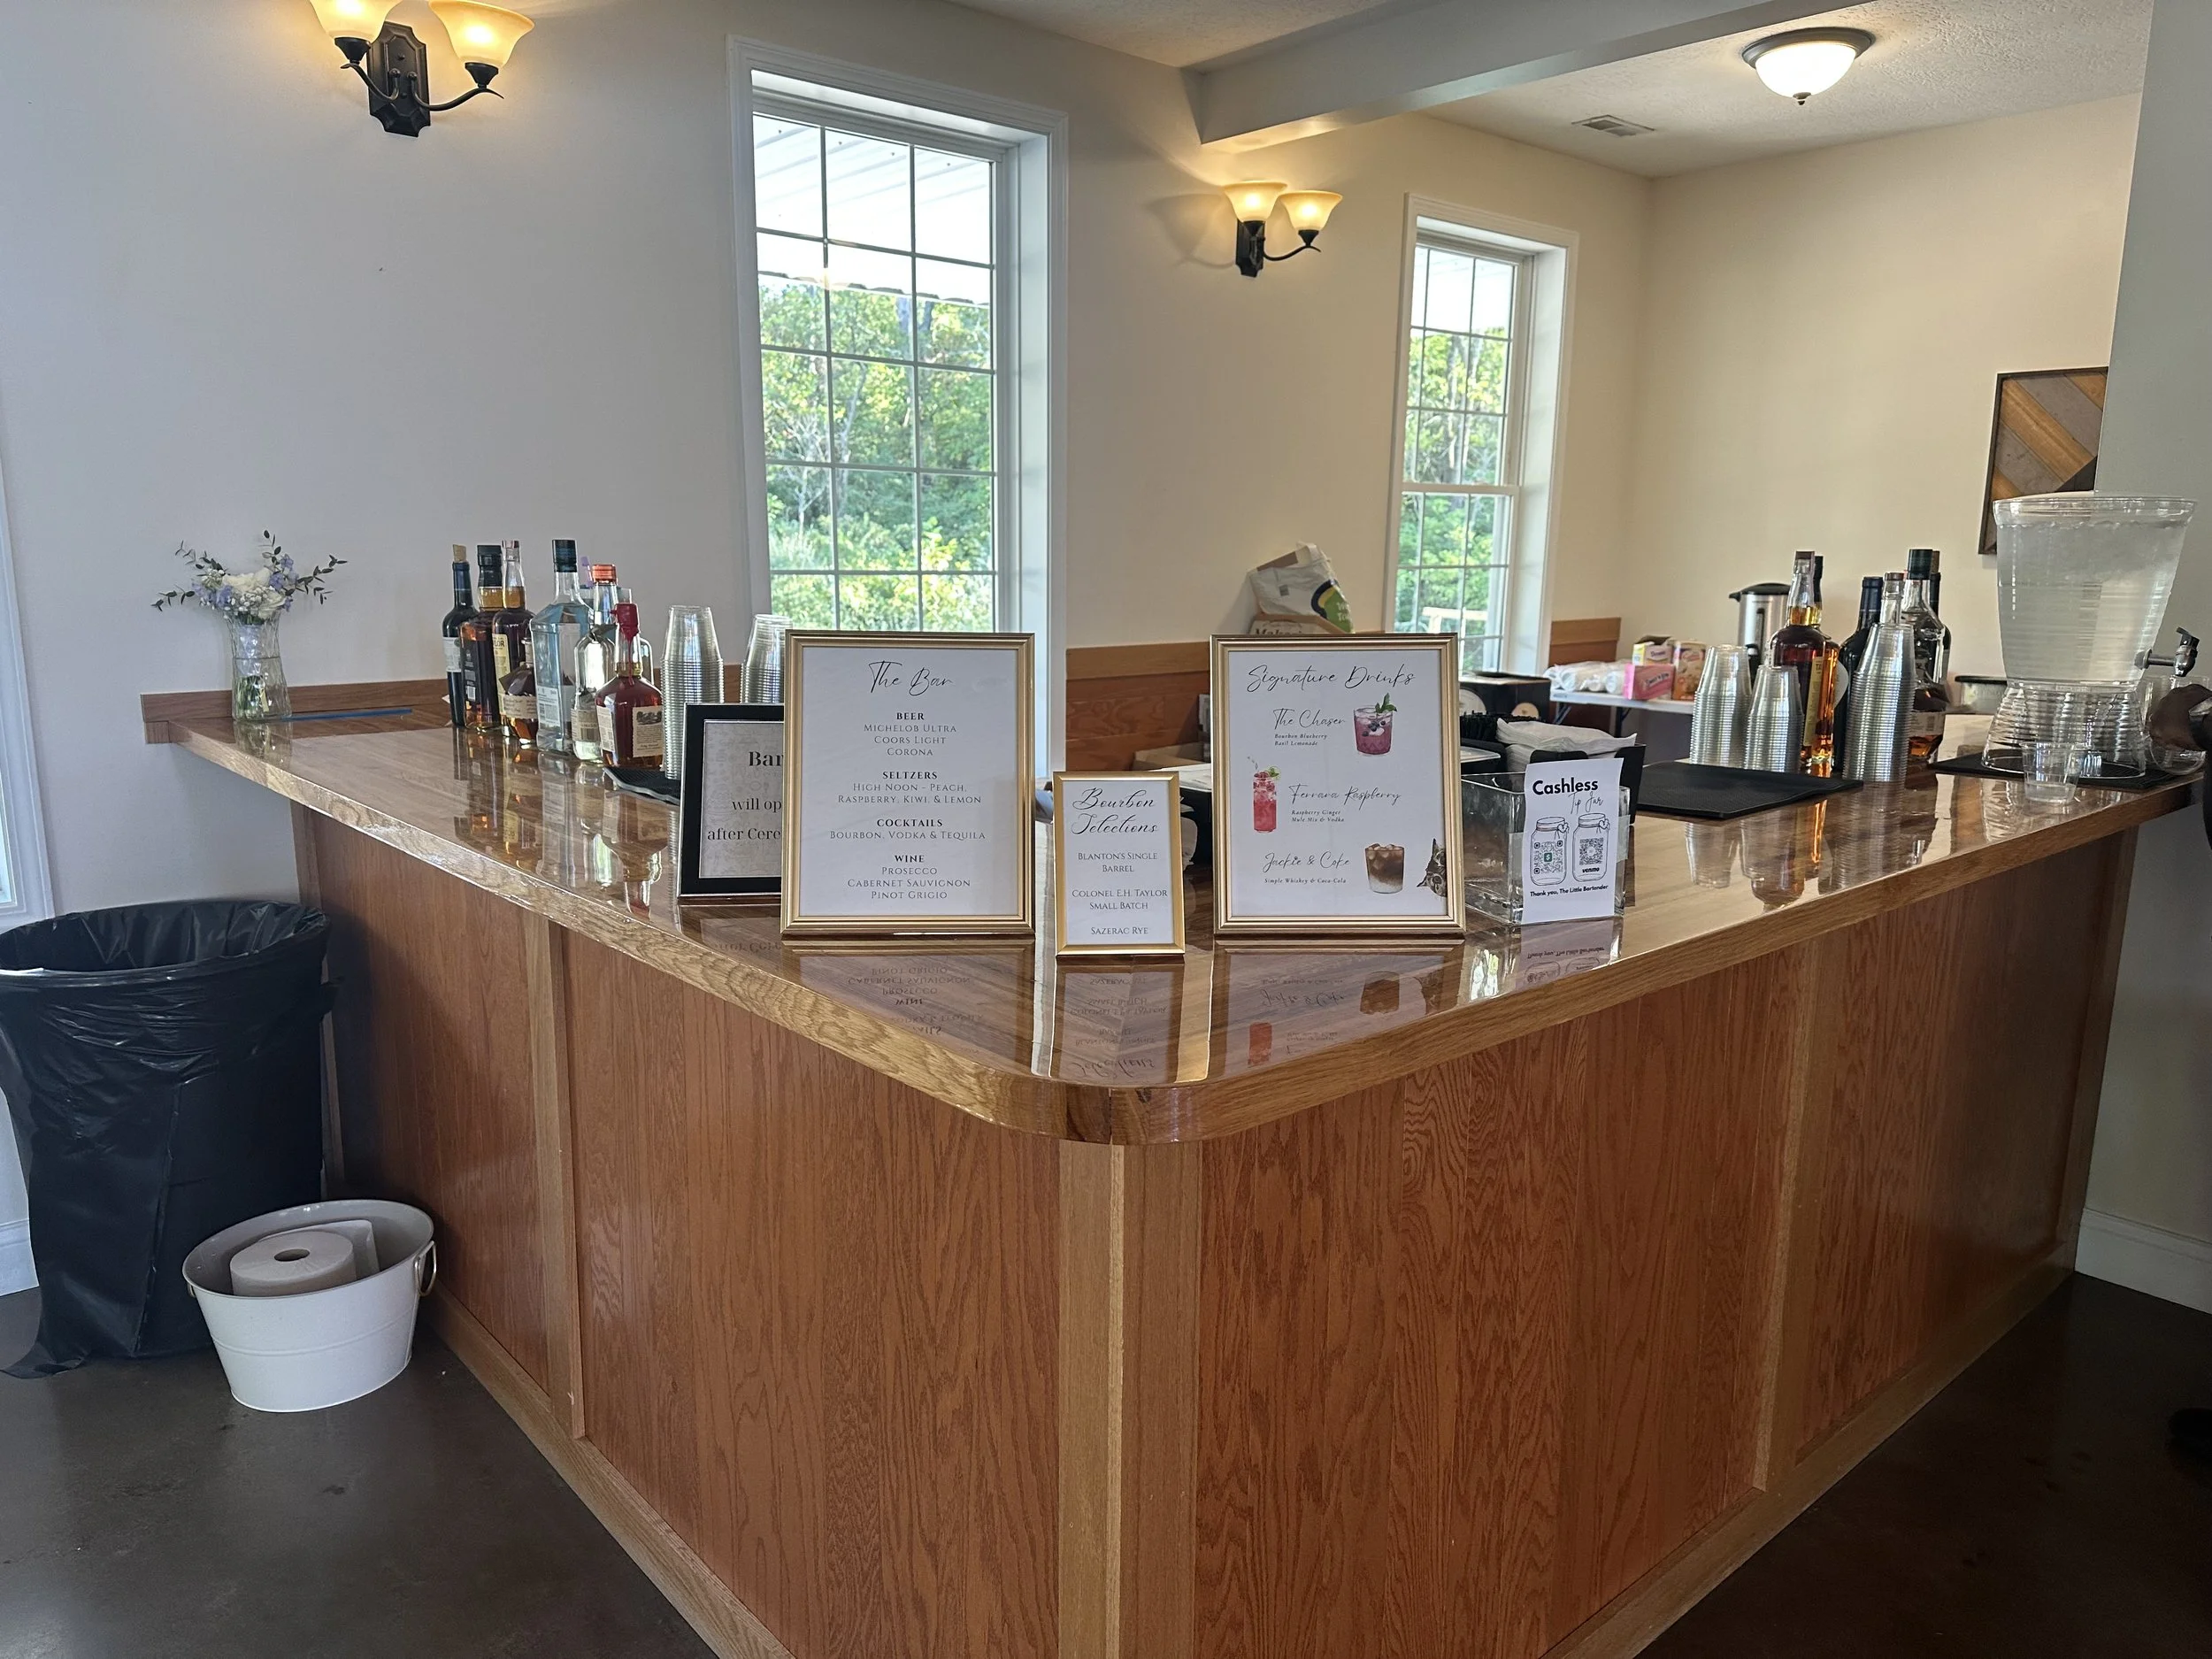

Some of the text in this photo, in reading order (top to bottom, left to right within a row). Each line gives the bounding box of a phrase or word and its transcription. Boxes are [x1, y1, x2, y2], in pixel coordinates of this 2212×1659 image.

[869, 660, 954, 696] The Bar
[1247, 664, 1415, 693] Signature Drinks
[1272, 708, 1347, 729] The Chaser
[864, 724, 920, 733] MICHELOB
[874, 736, 911, 745] COORS
[749, 751, 784, 766] Bar
[887, 748, 933, 757] CORONA
[882, 771, 938, 780] SELTZERS
[853, 783, 882, 792] HIGH
[885, 783, 919, 792] NOON
[1532, 777, 1599, 795] Cashless
[1072, 787, 1154, 810] Bourbon
[1343, 786, 1402, 810] Raspberry
[732, 798, 782, 812] will op
[876, 818, 943, 827] COCKTAILS
[708, 827, 781, 841] after Cere
[941, 831, 986, 841] TEQUILA
[895, 855, 925, 864] WINE
[1319, 850, 1350, 869] Coke
[848, 879, 972, 887] CABERNET SAUVIGNON
[871, 891, 948, 900] PINOT GRIGIO
